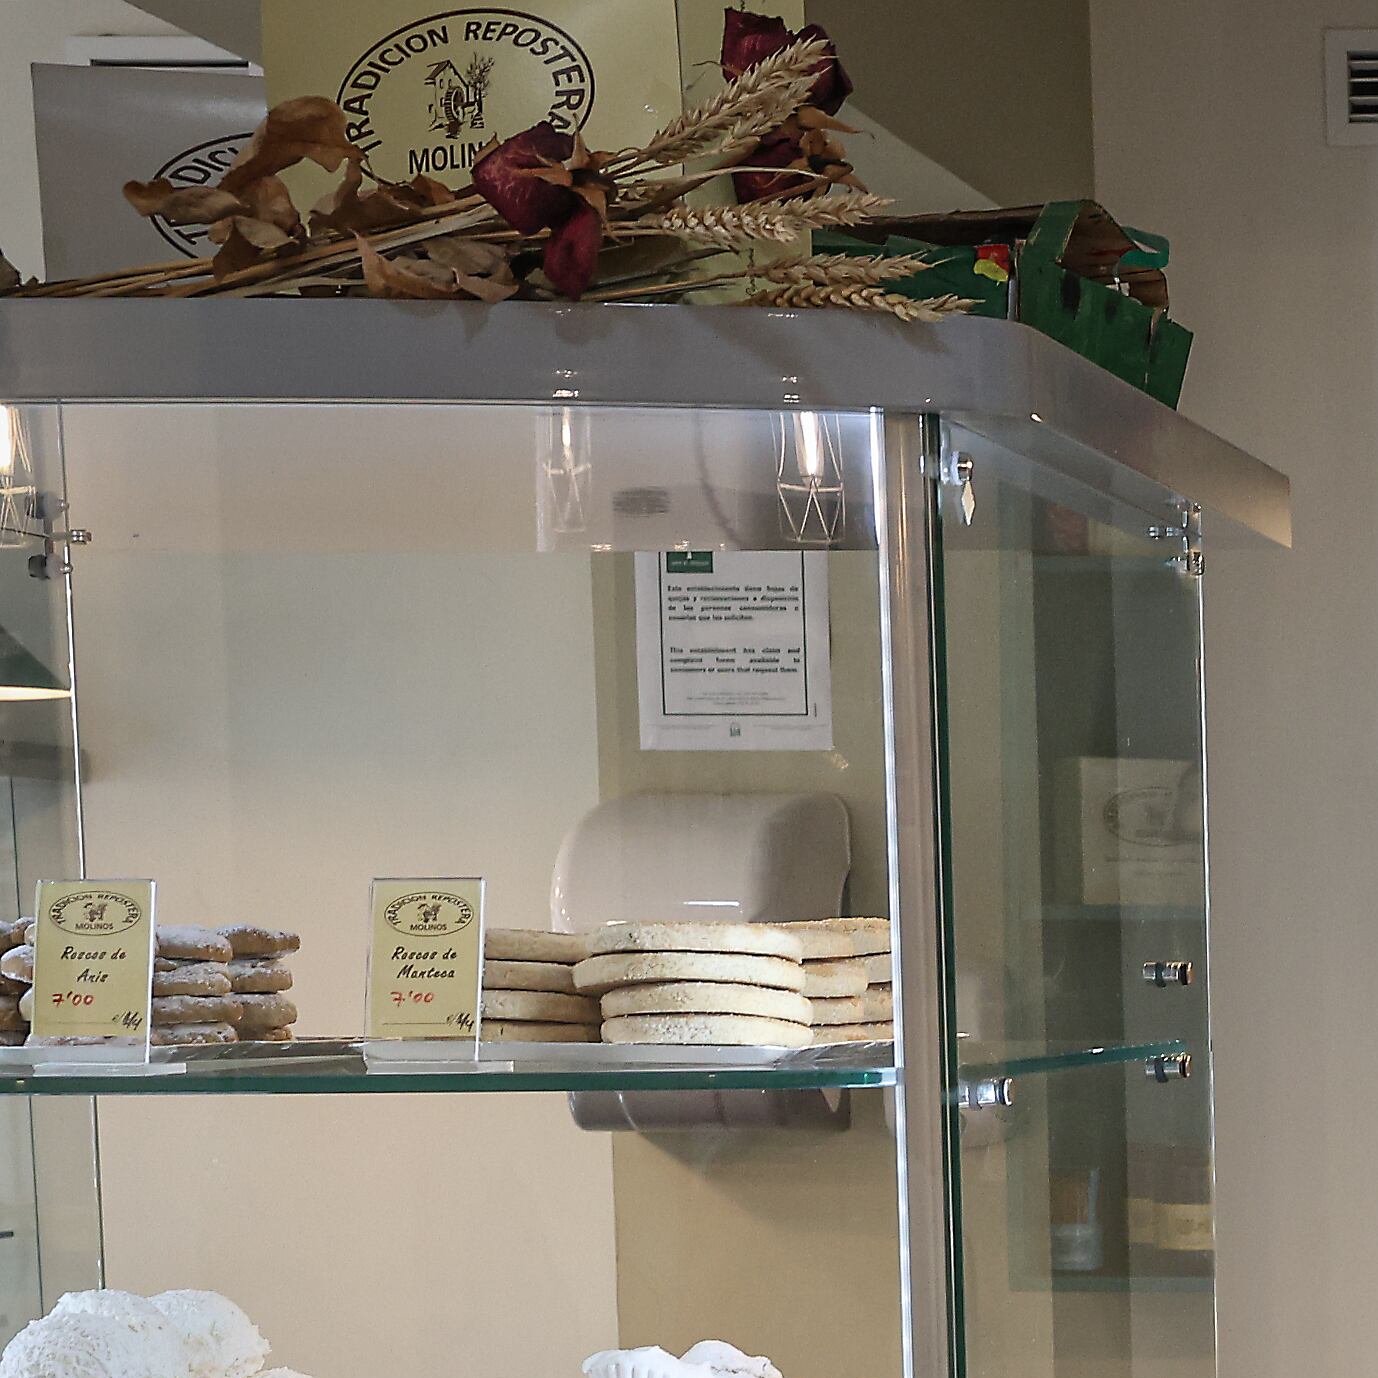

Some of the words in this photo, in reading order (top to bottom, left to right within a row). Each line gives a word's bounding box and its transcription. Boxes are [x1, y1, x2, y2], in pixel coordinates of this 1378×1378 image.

[409, 141, 482, 174] MOLIN
[75, 922, 114, 930] MOLINOS
[410, 923, 447, 931] MOLINOS
[61, 946, 106, 960] Roscos
[111, 948, 127, 960] de
[392, 946, 438, 960] Roscos
[442, 947, 457, 960] de
[397, 965, 455, 979] Manteca
